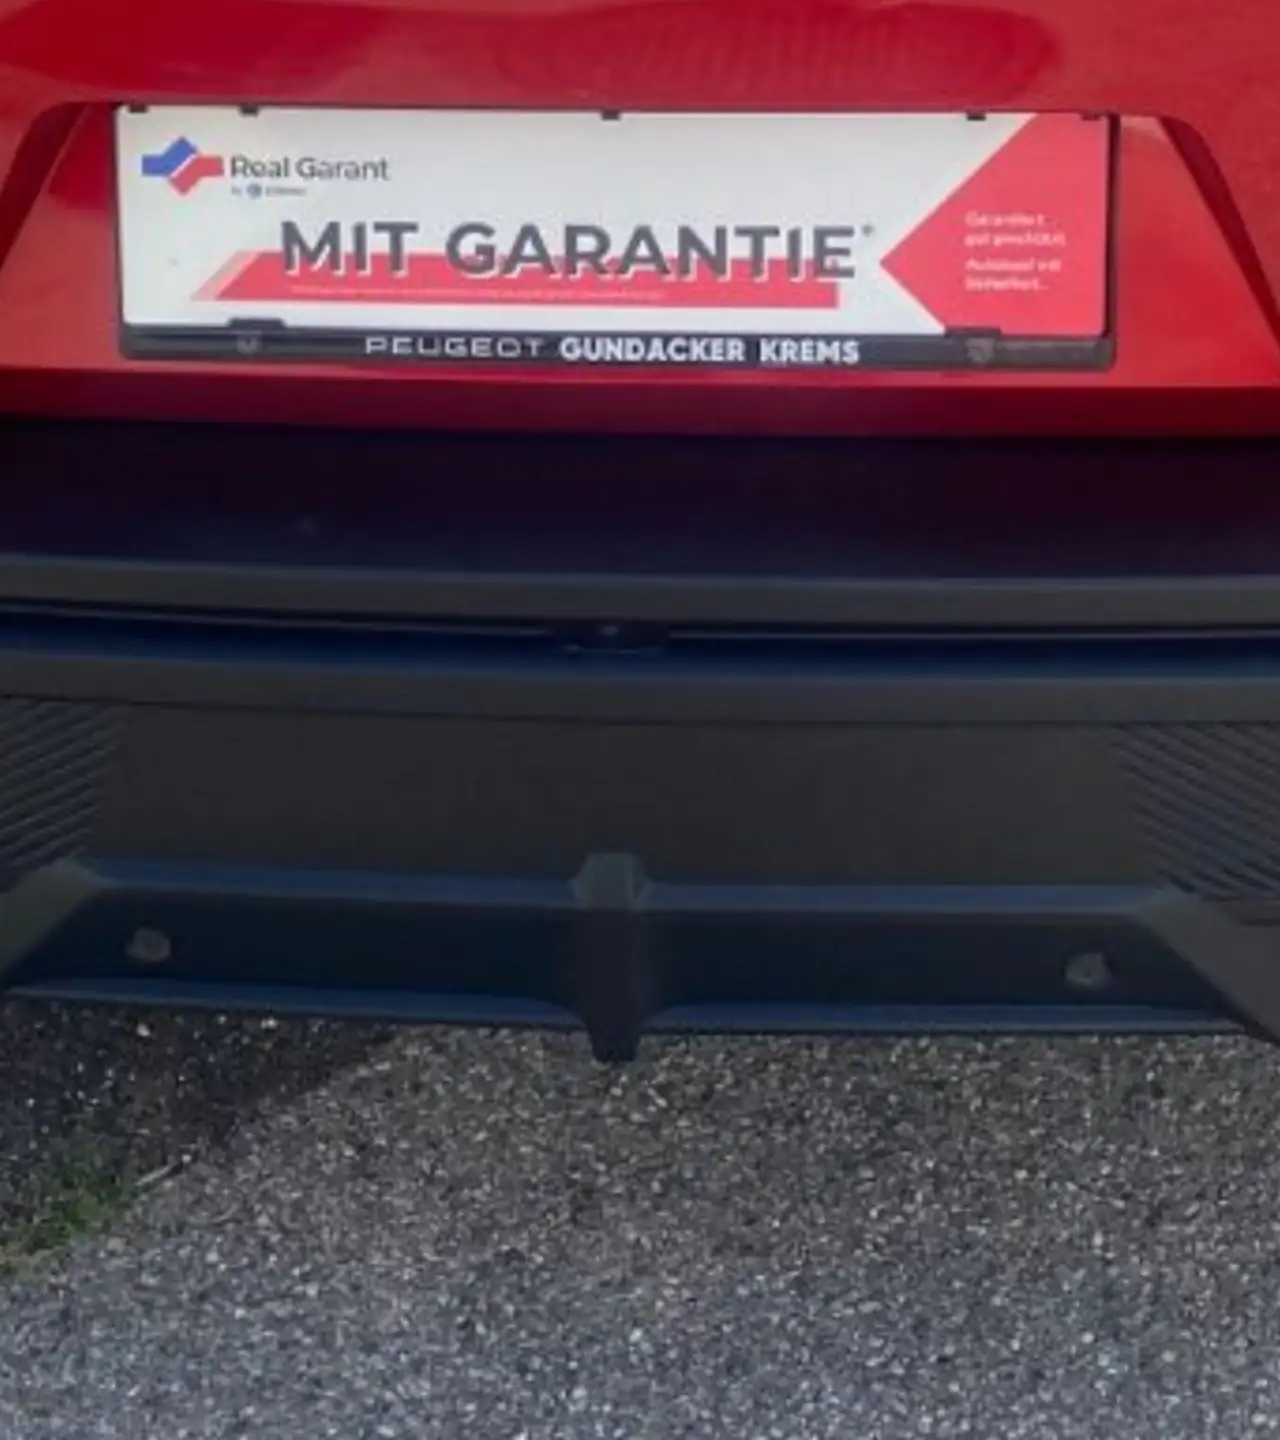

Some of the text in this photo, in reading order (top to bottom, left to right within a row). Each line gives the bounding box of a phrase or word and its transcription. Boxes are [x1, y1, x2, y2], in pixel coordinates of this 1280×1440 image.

[231, 157, 390, 180] Real Garant
[281, 221, 419, 274] MIT
[365, 336, 860, 366] PEUGEOT GUNDACKER KREMS
